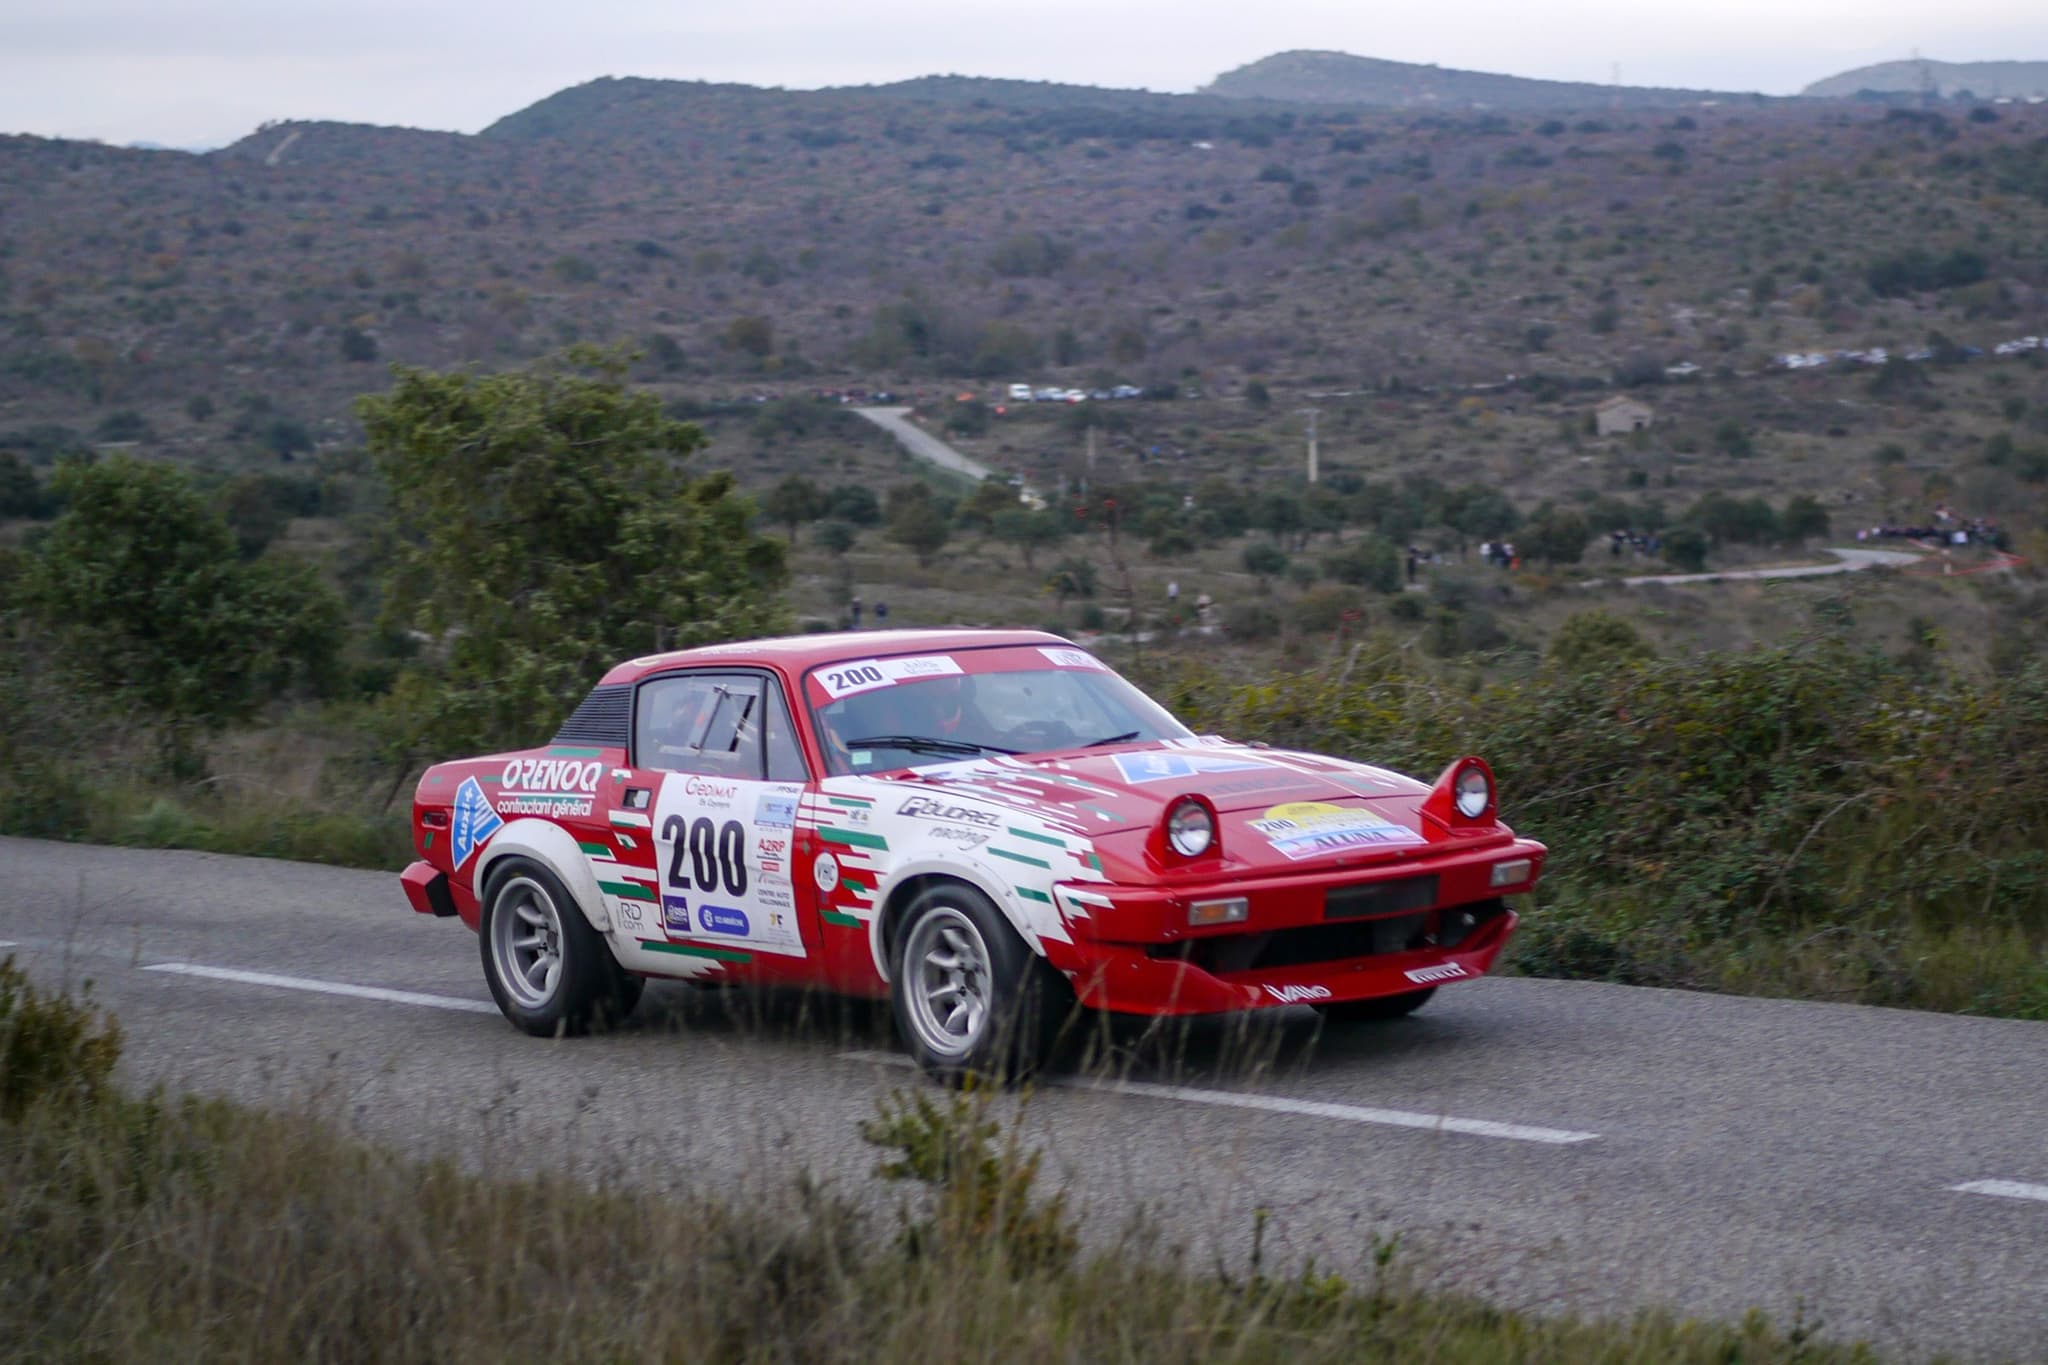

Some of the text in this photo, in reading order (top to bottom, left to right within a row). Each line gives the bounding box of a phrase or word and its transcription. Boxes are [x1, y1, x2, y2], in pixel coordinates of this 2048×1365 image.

[827, 666, 882, 691] 200
[497, 800, 593, 818] contractant général
[1260, 819, 1295, 832] 200
[928, 827, 990, 851] racing
[1314, 830, 1389, 848] ALUNA
[661, 814, 748, 897] 200
[1404, 962, 1468, 983] PIRELLI
